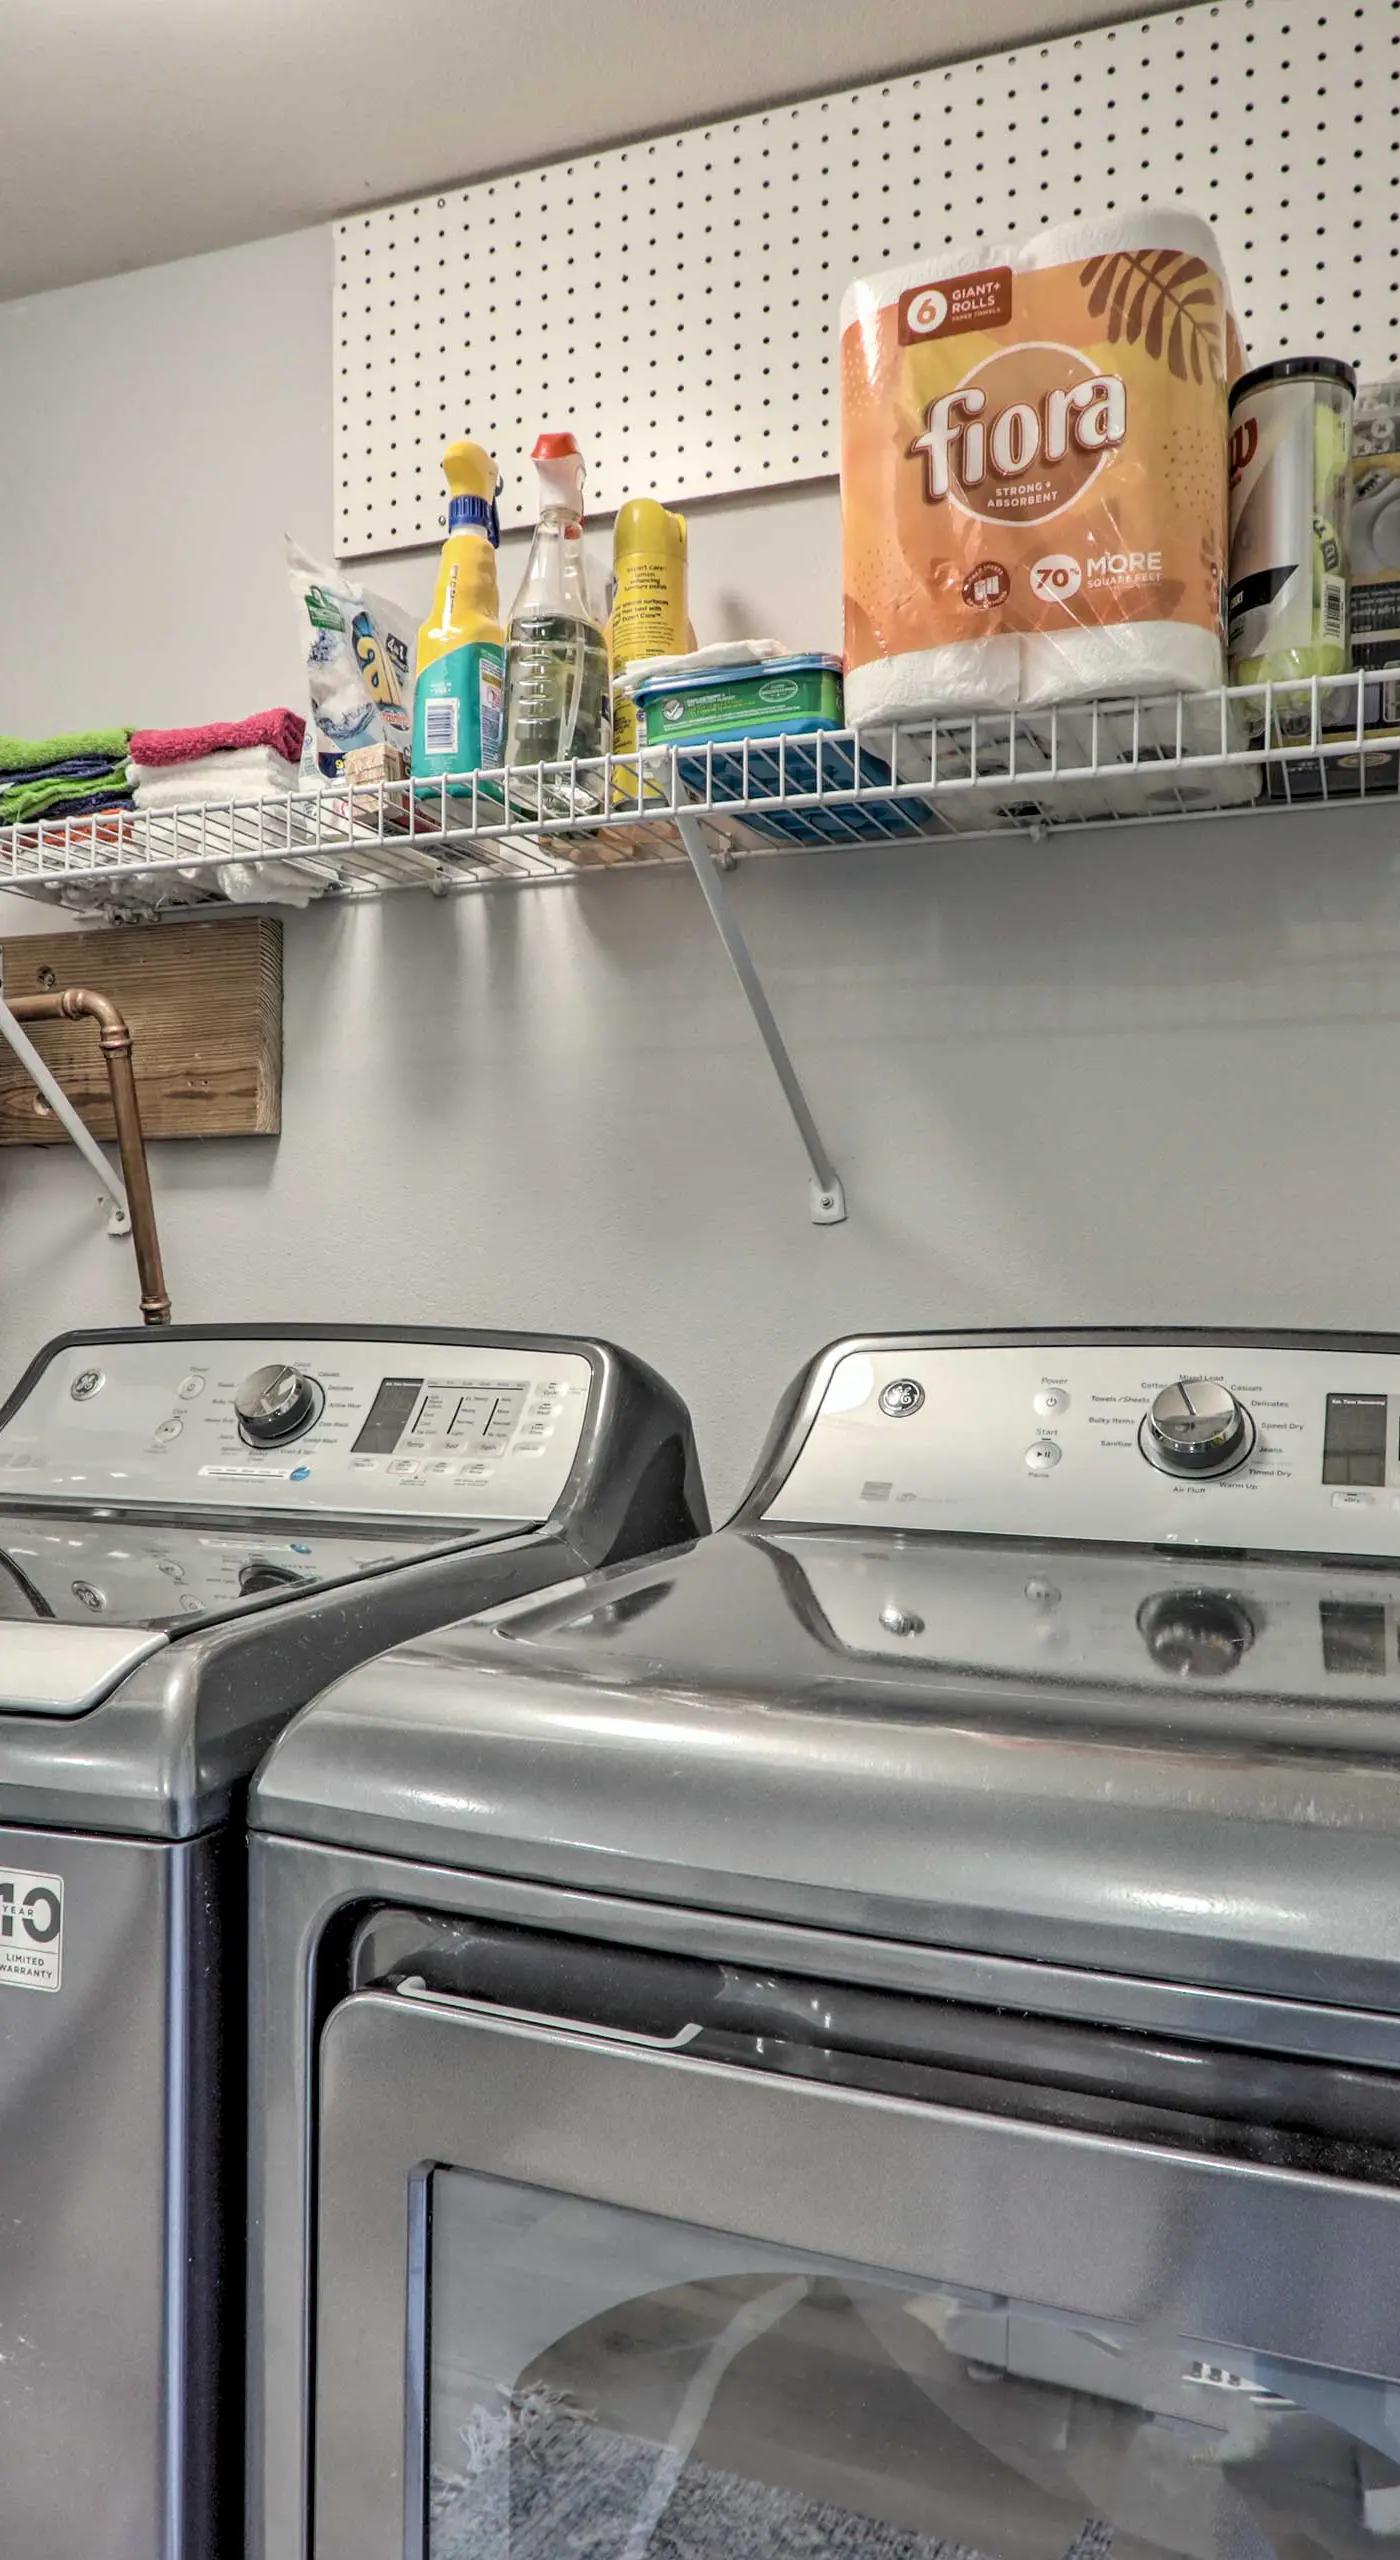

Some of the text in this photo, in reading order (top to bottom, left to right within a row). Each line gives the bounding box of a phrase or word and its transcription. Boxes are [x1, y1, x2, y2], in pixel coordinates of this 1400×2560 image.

[917, 298, 937, 325] 6
[952, 295, 995, 314] ROLLS
[911, 375, 1127, 499] fiora
[996, 482, 1043, 497] STRONG
[987, 490, 1058, 508] ABSORBENT
[1087, 551, 1162, 578] MORE
[1087, 573, 1161, 589] SQUARE FEET
[1041, 1377, 1068, 1386] Power
[1230, 1384, 1263, 1392] Casuals
[1251, 1400, 1289, 1408] Delicates
[1035, 1428, 1058, 1436] Start
[1249, 1468, 1292, 1478] Timed Dry
[2, 1904, 34, 1917] YEAR
[6, 1953, 45, 1967] LIMITED
[0, 1964, 53, 1979] WARRANTY
